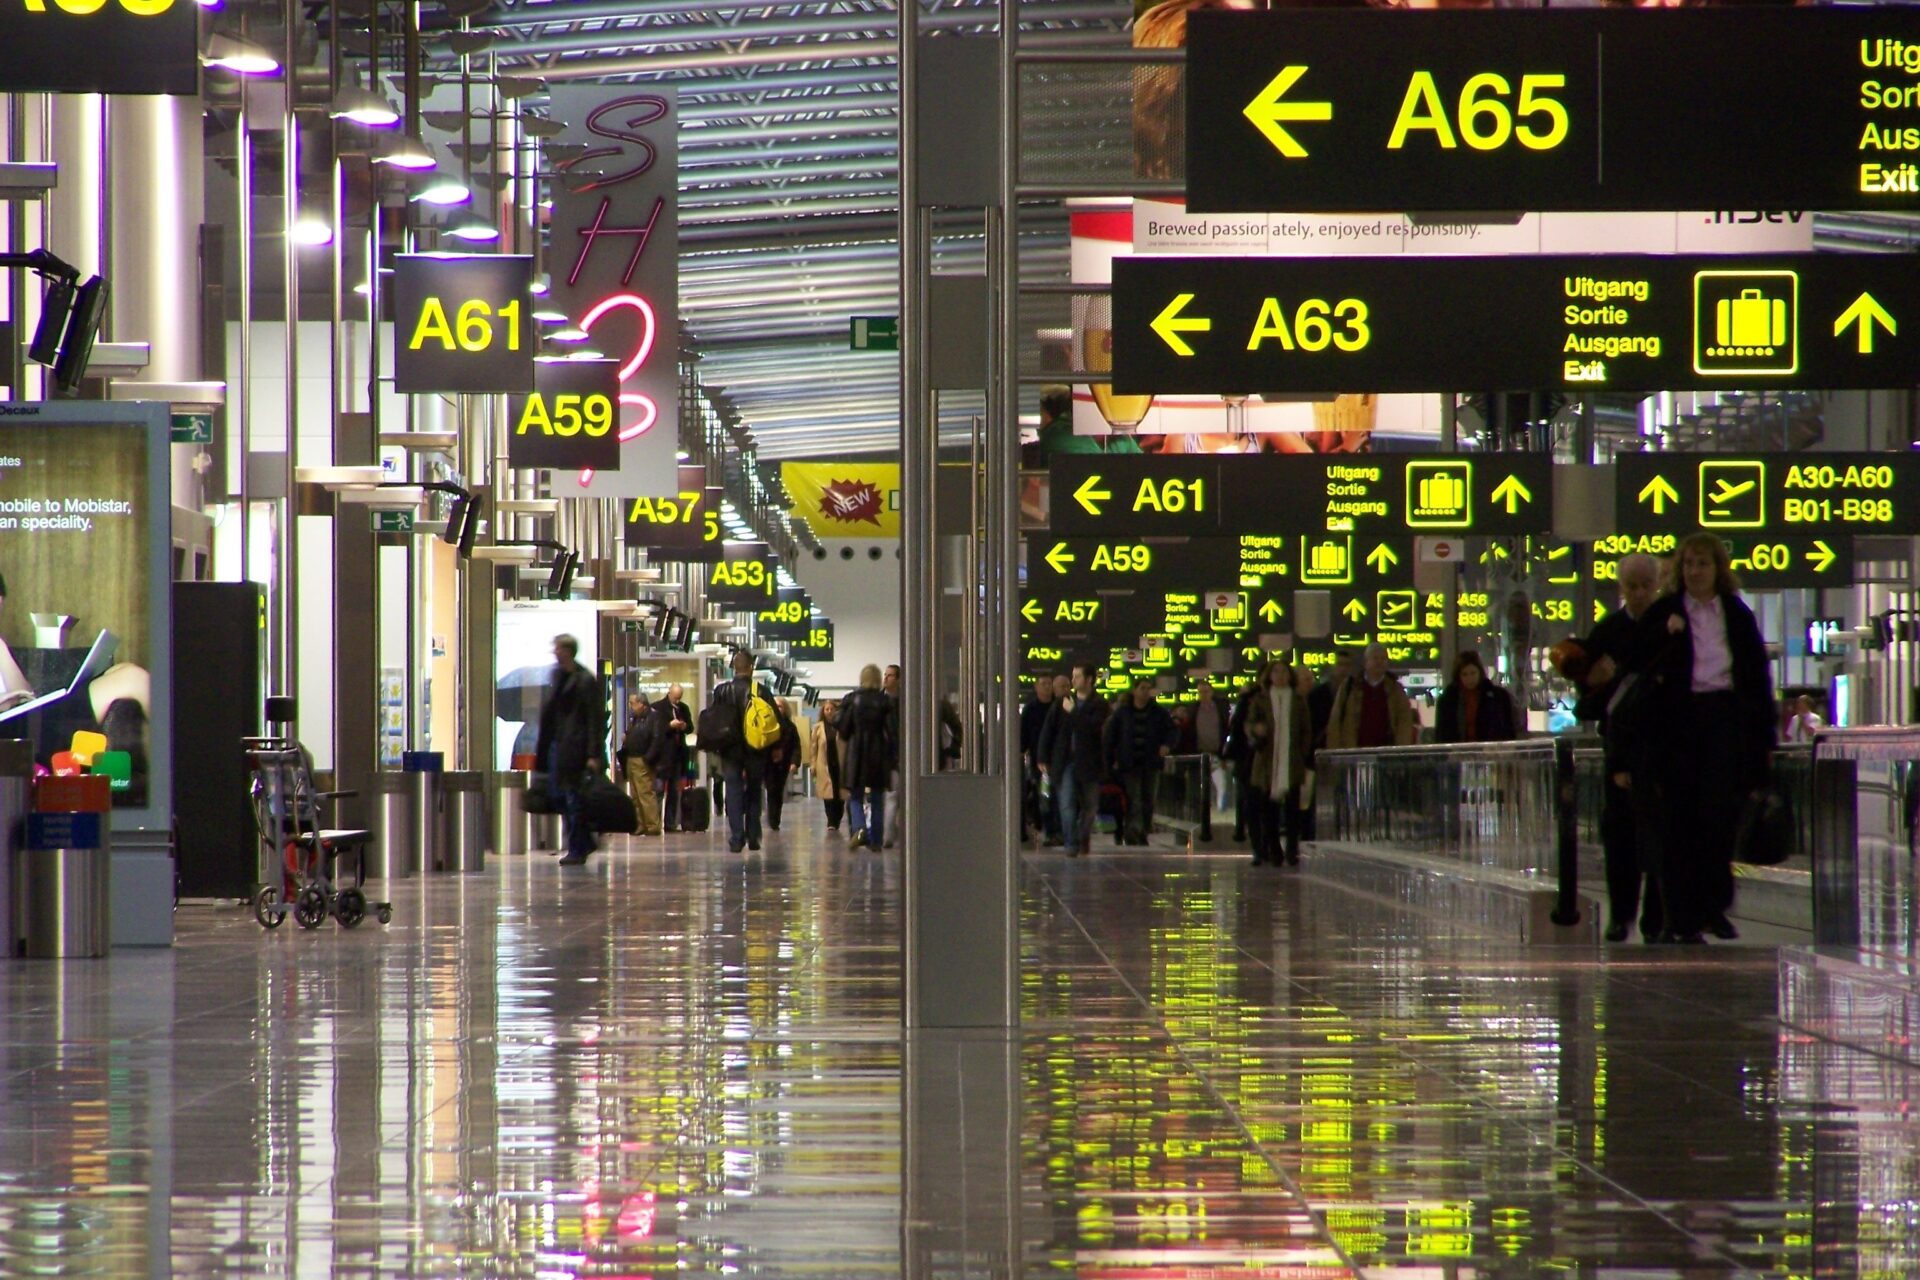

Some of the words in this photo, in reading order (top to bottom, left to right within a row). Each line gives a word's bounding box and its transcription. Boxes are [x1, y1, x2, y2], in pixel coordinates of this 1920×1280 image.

[1387, 72, 1568, 150] A65
[1861, 163, 1919, 192] Exit
[1148, 221, 1207, 236] Brewed
[1318, 221, 1381, 240] enjoyed
[1565, 277, 1649, 302] Uitgang
[409, 297, 520, 351] A61
[1247, 298, 1370, 352] A63
[1565, 304, 1628, 325] Sortie
[1564, 332, 1661, 358] Ausgang
[1565, 360, 1607, 381] Exit
[516, 393, 613, 437] A59
[1326, 466, 1379, 481] Uitgang
[1784, 466, 1893, 489] A30-A60
[1132, 479, 1204, 512] A61
[1326, 482, 1367, 496] Sortie
[45, 499, 61, 513] to
[64, 498, 132, 515] Mobistar,
[629, 492, 701, 523] A57
[832, 488, 872, 517] NEW
[1326, 500, 1386, 516] Ausgang
[1784, 499, 1893, 523] B01-B98
[21, 514, 93, 532] speciality.
[1240, 536, 1282, 549] Uitgang
[1594, 534, 1676, 554] A30-A58
[1090, 545, 1151, 572] A59
[1240, 549, 1272, 560] Sortie
[711, 561, 765, 586] A53
[1240, 562, 1287, 575] Ausgang
[1055, 601, 1099, 622] A57
